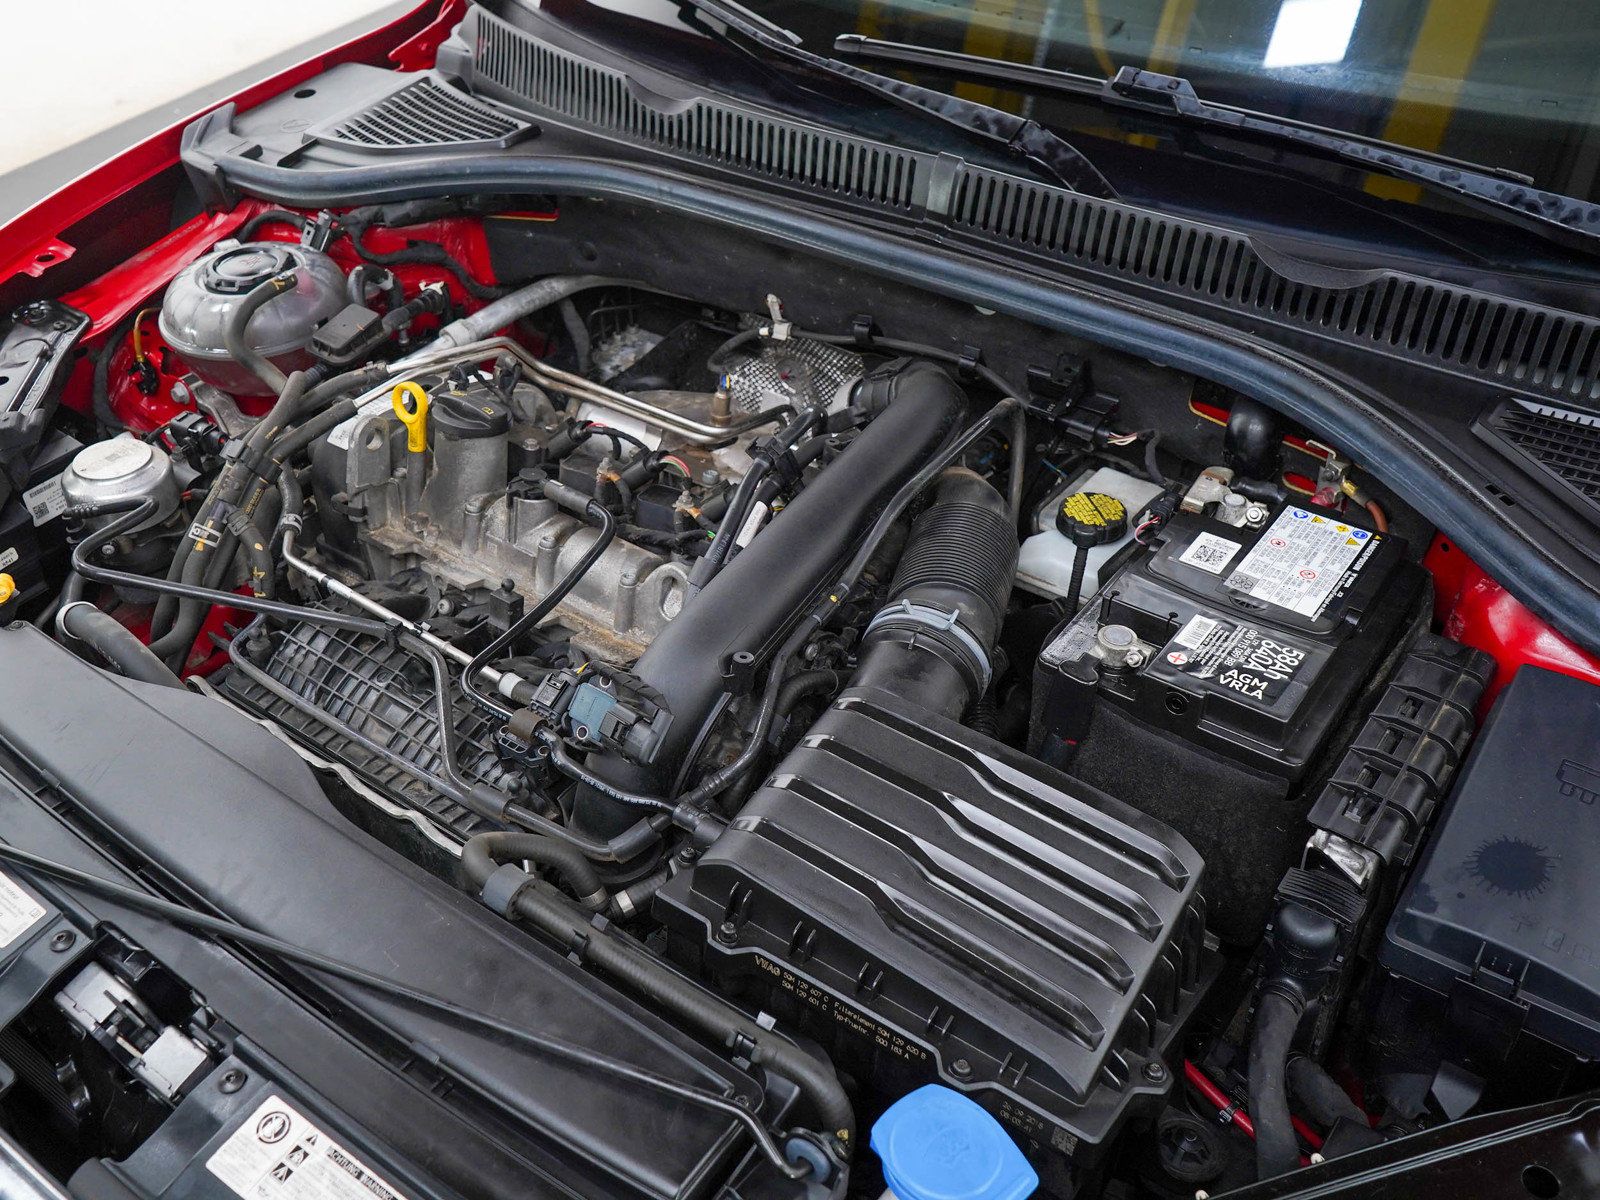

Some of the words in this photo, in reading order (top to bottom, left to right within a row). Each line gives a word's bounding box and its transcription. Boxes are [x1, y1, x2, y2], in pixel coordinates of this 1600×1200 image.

[1238, 638, 1251, 649] 915
[1242, 639, 1282, 672] 640A
[1263, 647, 1306, 680] 58Ah
[1219, 673, 1263, 700] VRLA
[1224, 668, 1269, 691] AGM
[796, 988, 807, 998] 129
[797, 980, 809, 989] 129
